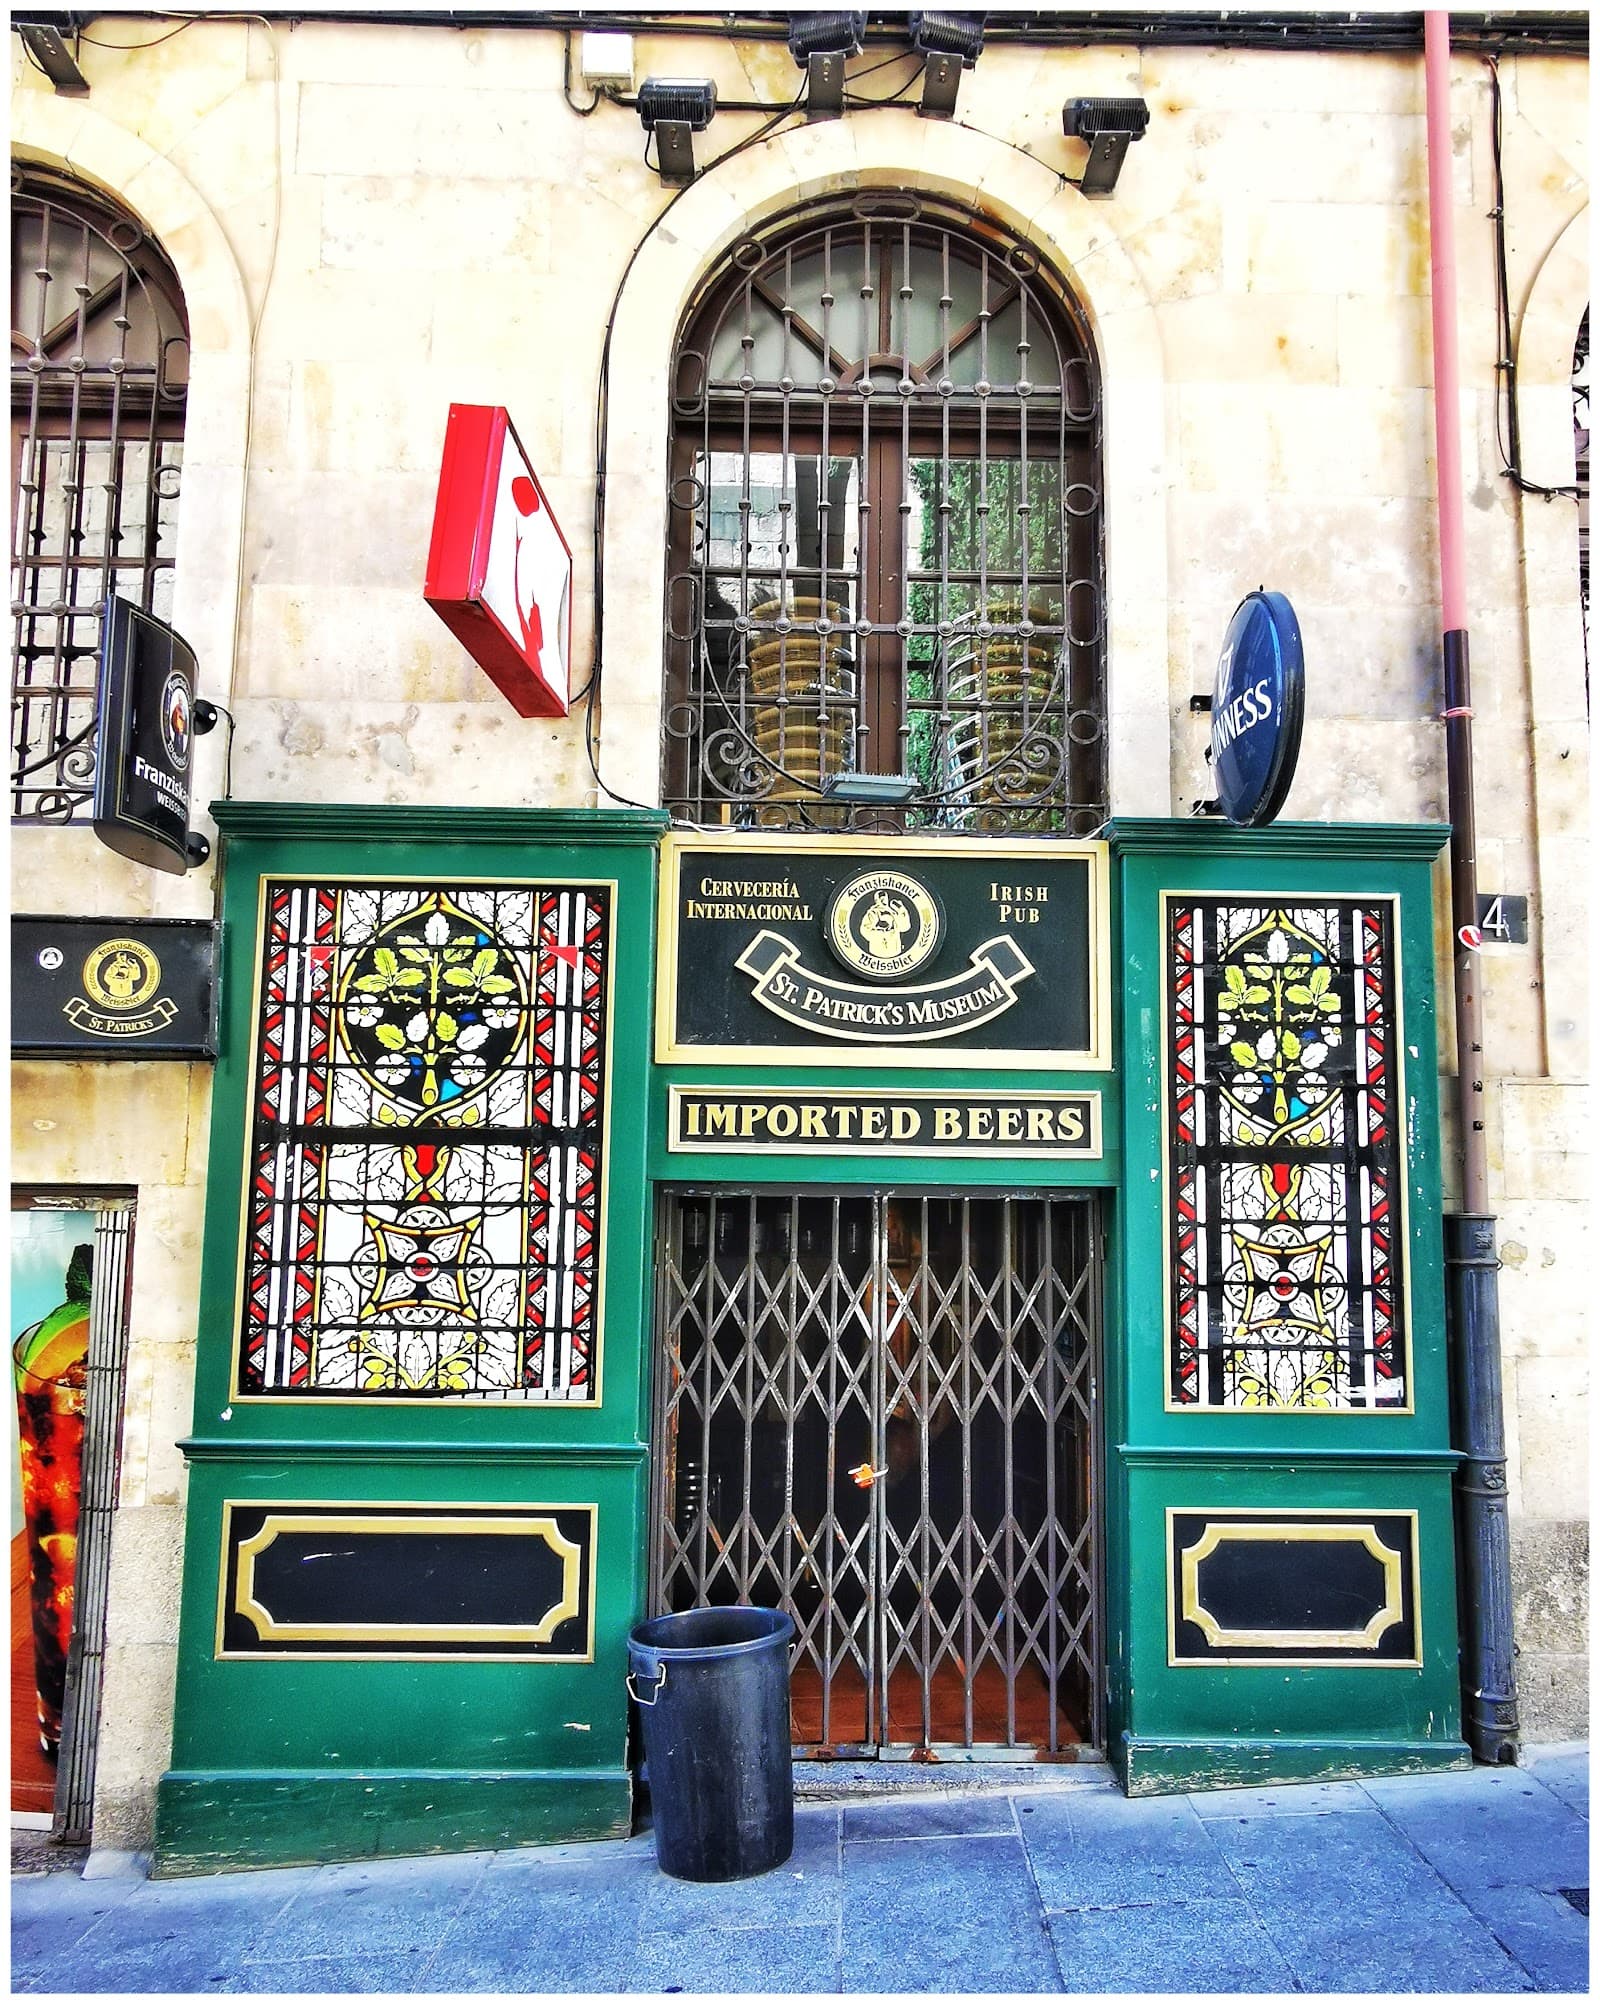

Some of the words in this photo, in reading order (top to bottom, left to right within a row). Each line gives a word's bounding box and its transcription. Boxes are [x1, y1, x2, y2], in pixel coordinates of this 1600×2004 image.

[700, 877, 801, 899] CERVECERÍA
[847, 877, 920, 901] Franziskaner
[989, 882, 1048, 902] IRISH
[686, 899, 813, 922] INTERNACIONAL
[999, 905, 1040, 924] PUB
[1482, 896, 1505, 936] 4
[859, 954, 915, 971] Weissbier
[767, 973, 798, 1004] ST.
[801, 989, 903, 1026] PATRICK'S
[908, 979, 1005, 1024] MUSEUM
[686, 1103, 921, 1139] IMPORTED
[932, 1108, 1086, 1141] BEERS
